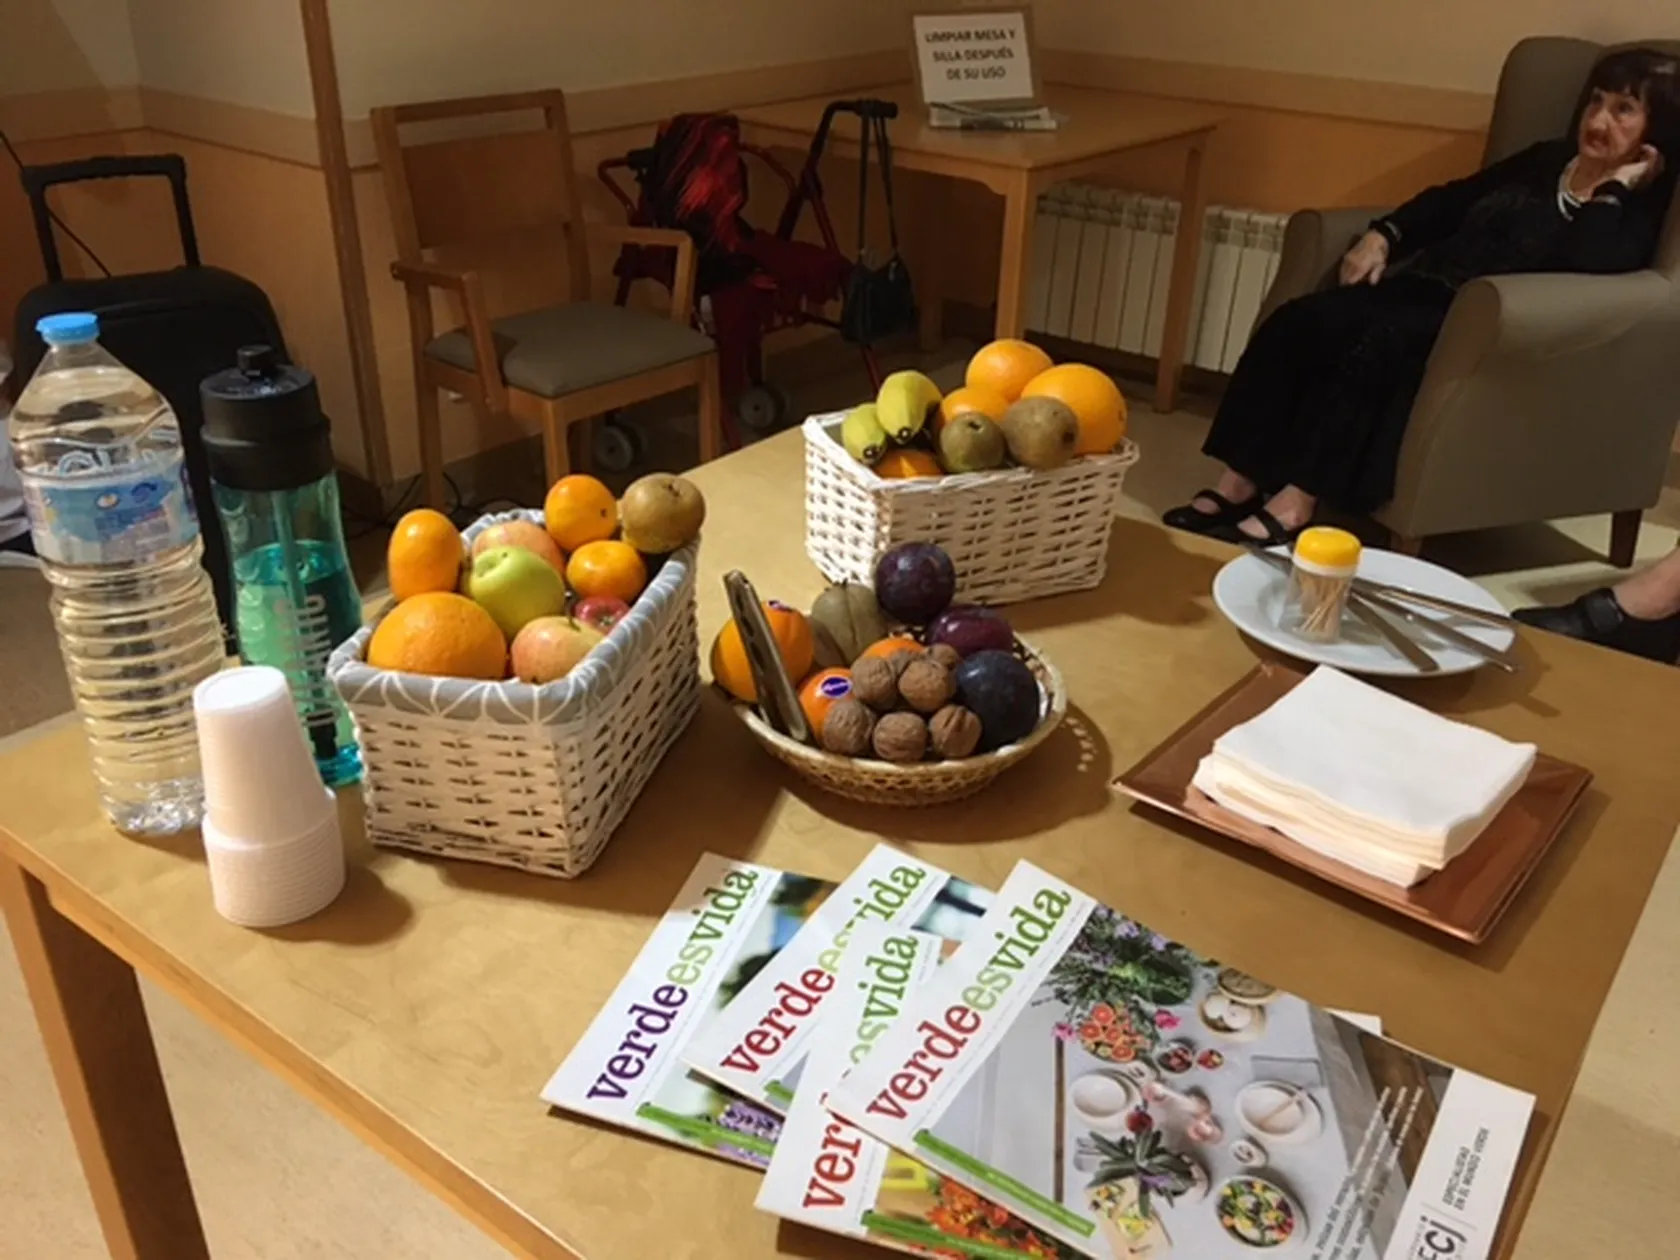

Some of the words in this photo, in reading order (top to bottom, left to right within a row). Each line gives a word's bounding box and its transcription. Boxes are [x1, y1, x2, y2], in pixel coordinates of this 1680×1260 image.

[924, 30, 972, 43] LIMPIAR
[973, 28, 1006, 40] MESA
[1007, 27, 1016, 39] Y
[932, 49, 962, 63] SILLA
[963, 45, 1015, 60] DESPUÉS
[946, 67, 961, 80] DE
[963, 67, 979, 80] SU
[981, 65, 1007, 80] USO
